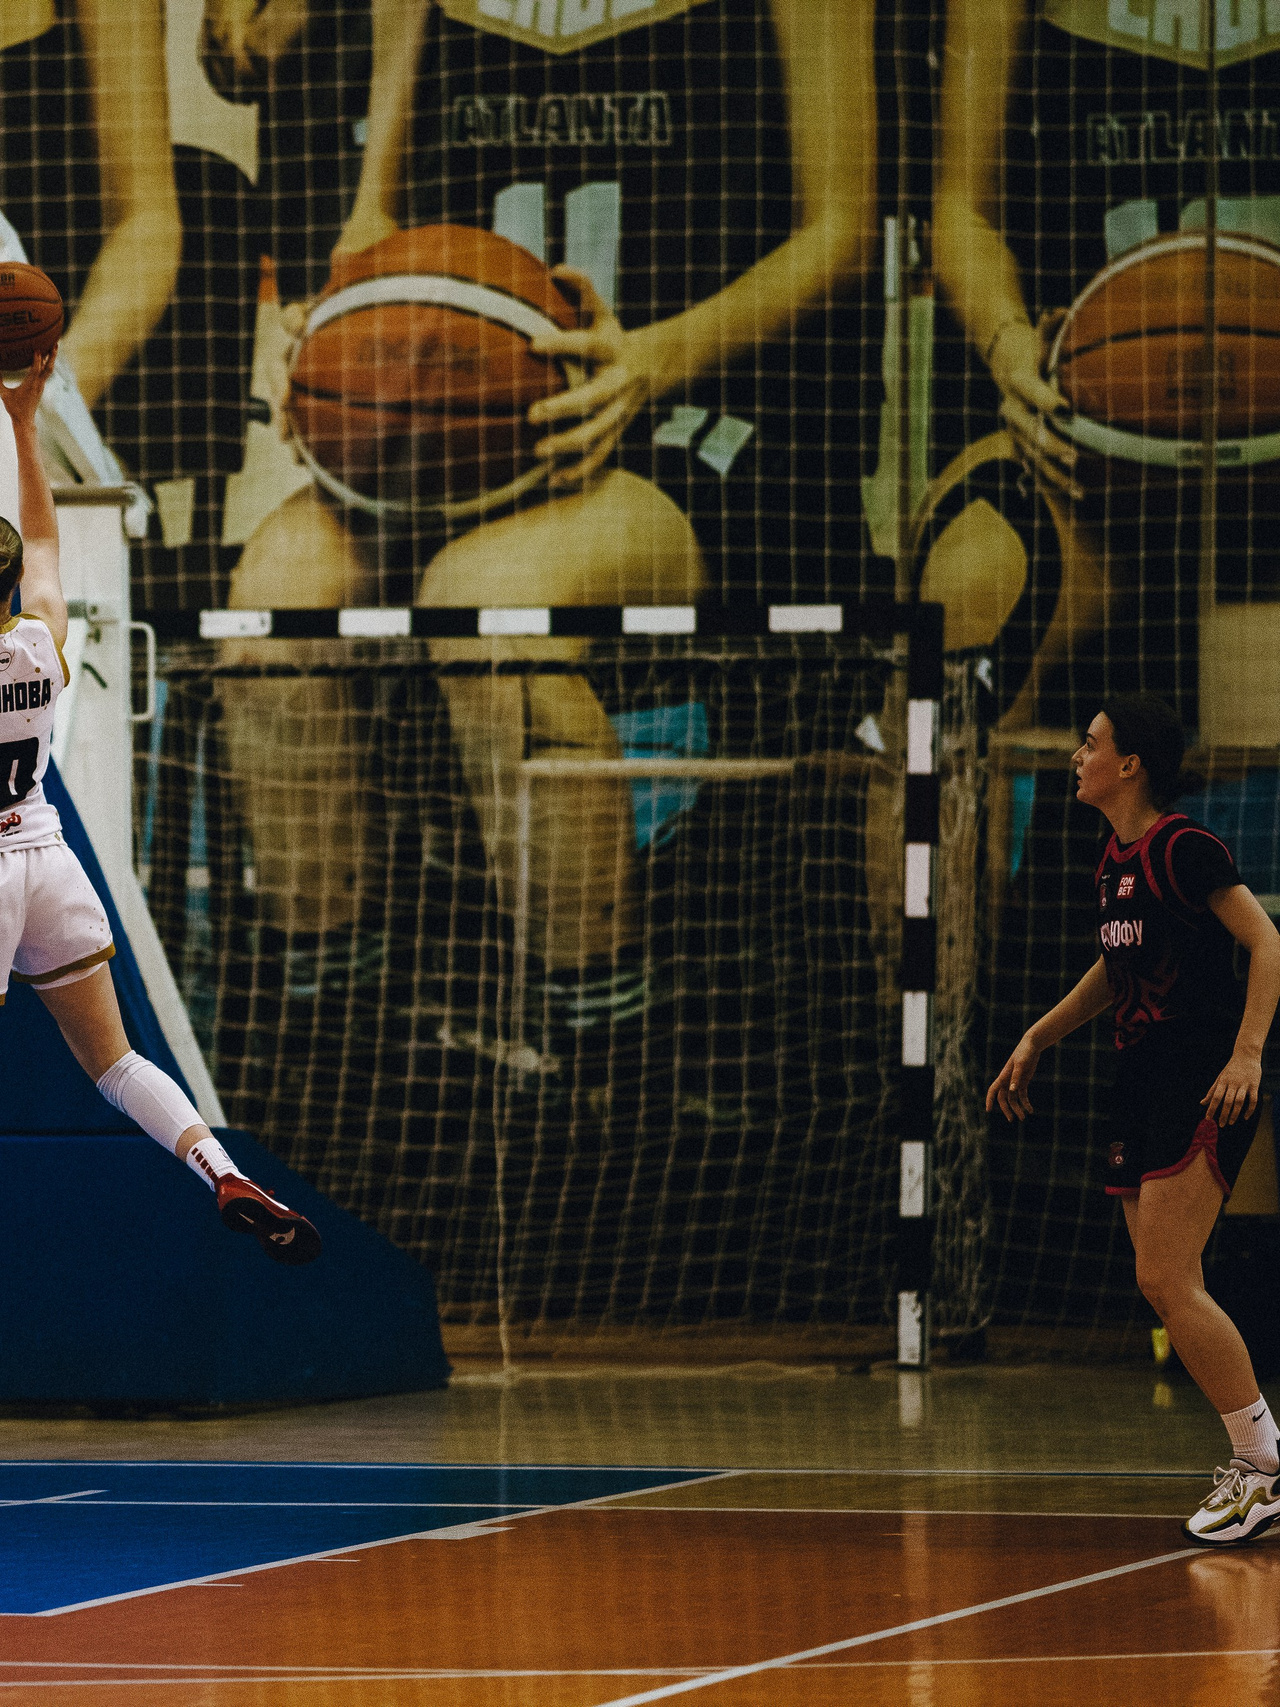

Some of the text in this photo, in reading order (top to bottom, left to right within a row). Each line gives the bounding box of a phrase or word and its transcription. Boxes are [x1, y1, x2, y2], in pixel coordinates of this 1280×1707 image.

[452, 90, 671, 147] ATLANTA
[1119, 877, 1135, 887] FON
[1117, 886, 1134, 897] BET
